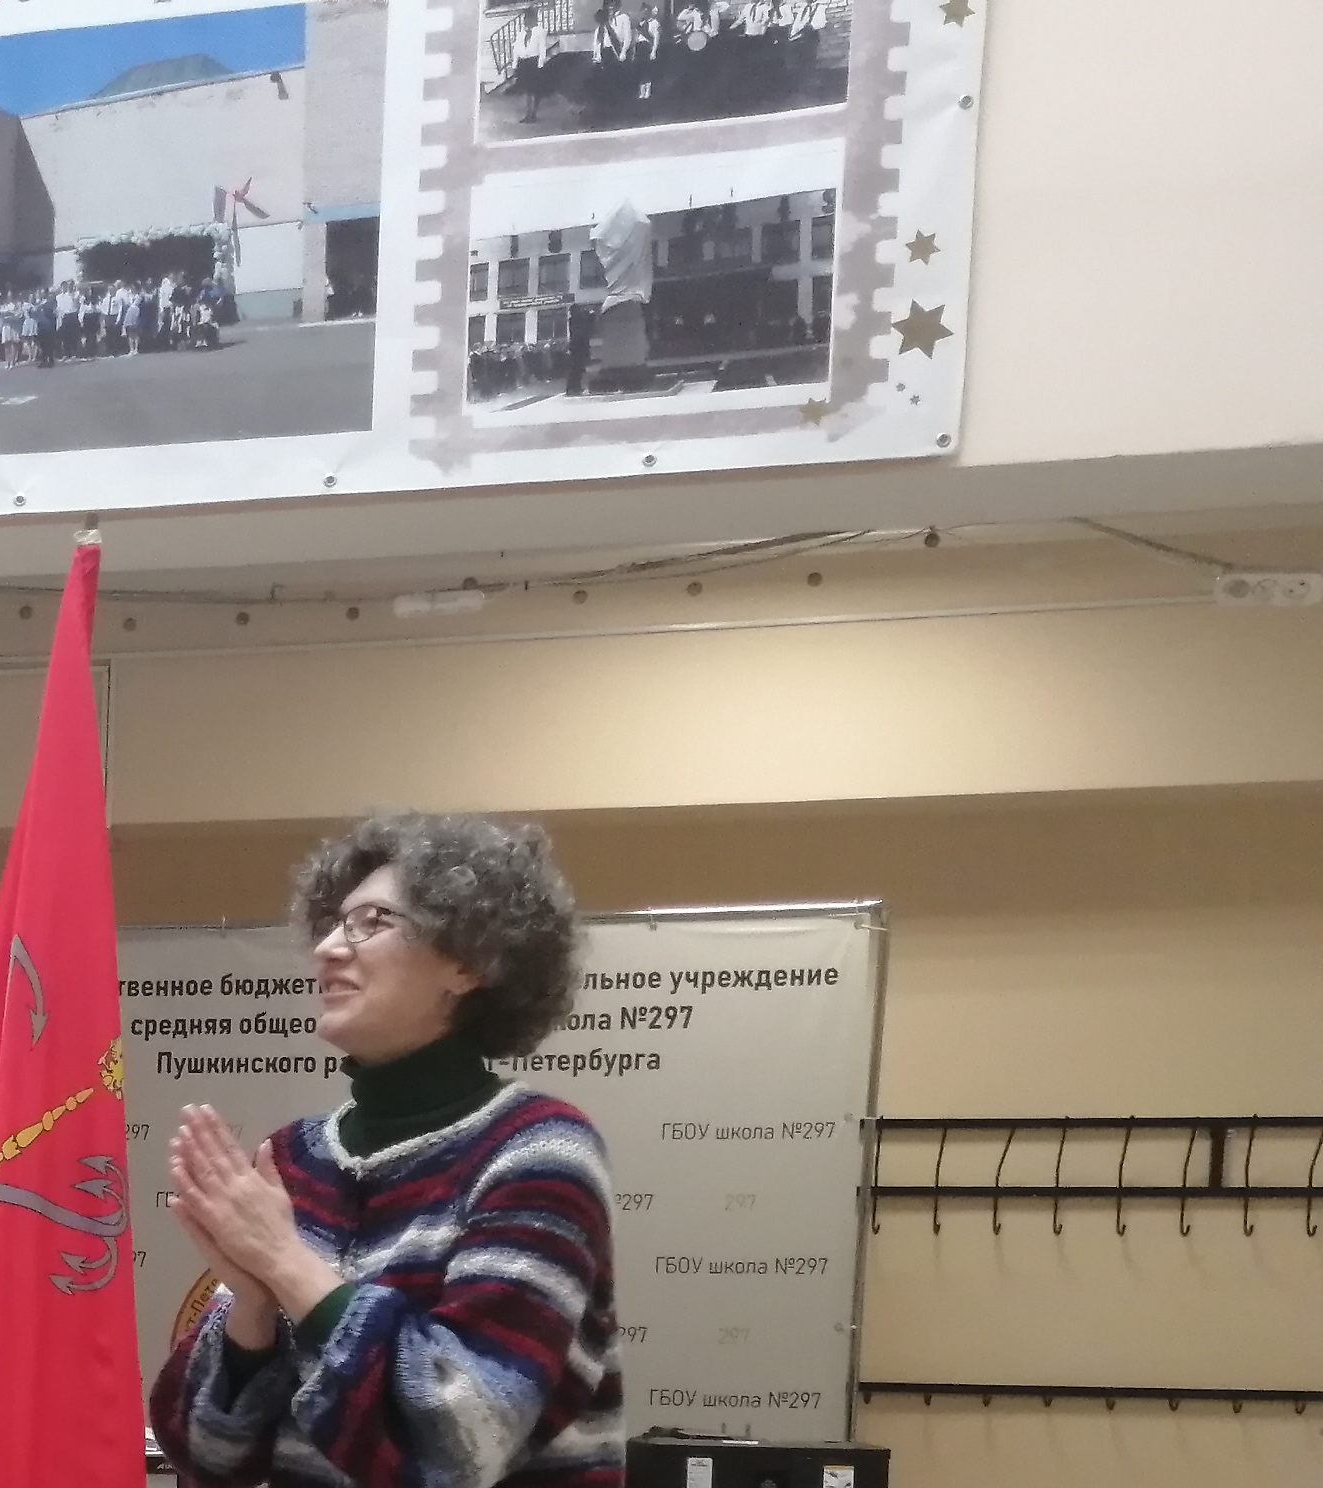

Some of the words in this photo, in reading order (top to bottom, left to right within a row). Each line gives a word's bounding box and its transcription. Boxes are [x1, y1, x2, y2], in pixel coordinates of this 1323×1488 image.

[220, 972, 327, 999] бюджет
[669, 966, 840, 996] учреждение
[130, 1017, 233, 1042] средняя
[239, 1011, 319, 1038] общео
[554, 1011, 612, 1032] ола
[620, 1005, 694, 1031] №297
[156, 1051, 317, 1080] Пушкинского
[661, 1122, 710, 1141] ГБОУ
[715, 1125, 775, 1141] школа
[781, 1121, 837, 1140] №297
[654, 1256, 703, 1275] ГБОУ
[708, 1260, 768, 1275] школа
[774, 1257, 829, 1275] №297
[649, 1388, 697, 1407] ГБОУ
[702, 1392, 762, 1408] школа
[767, 1391, 822, 1409] №297
